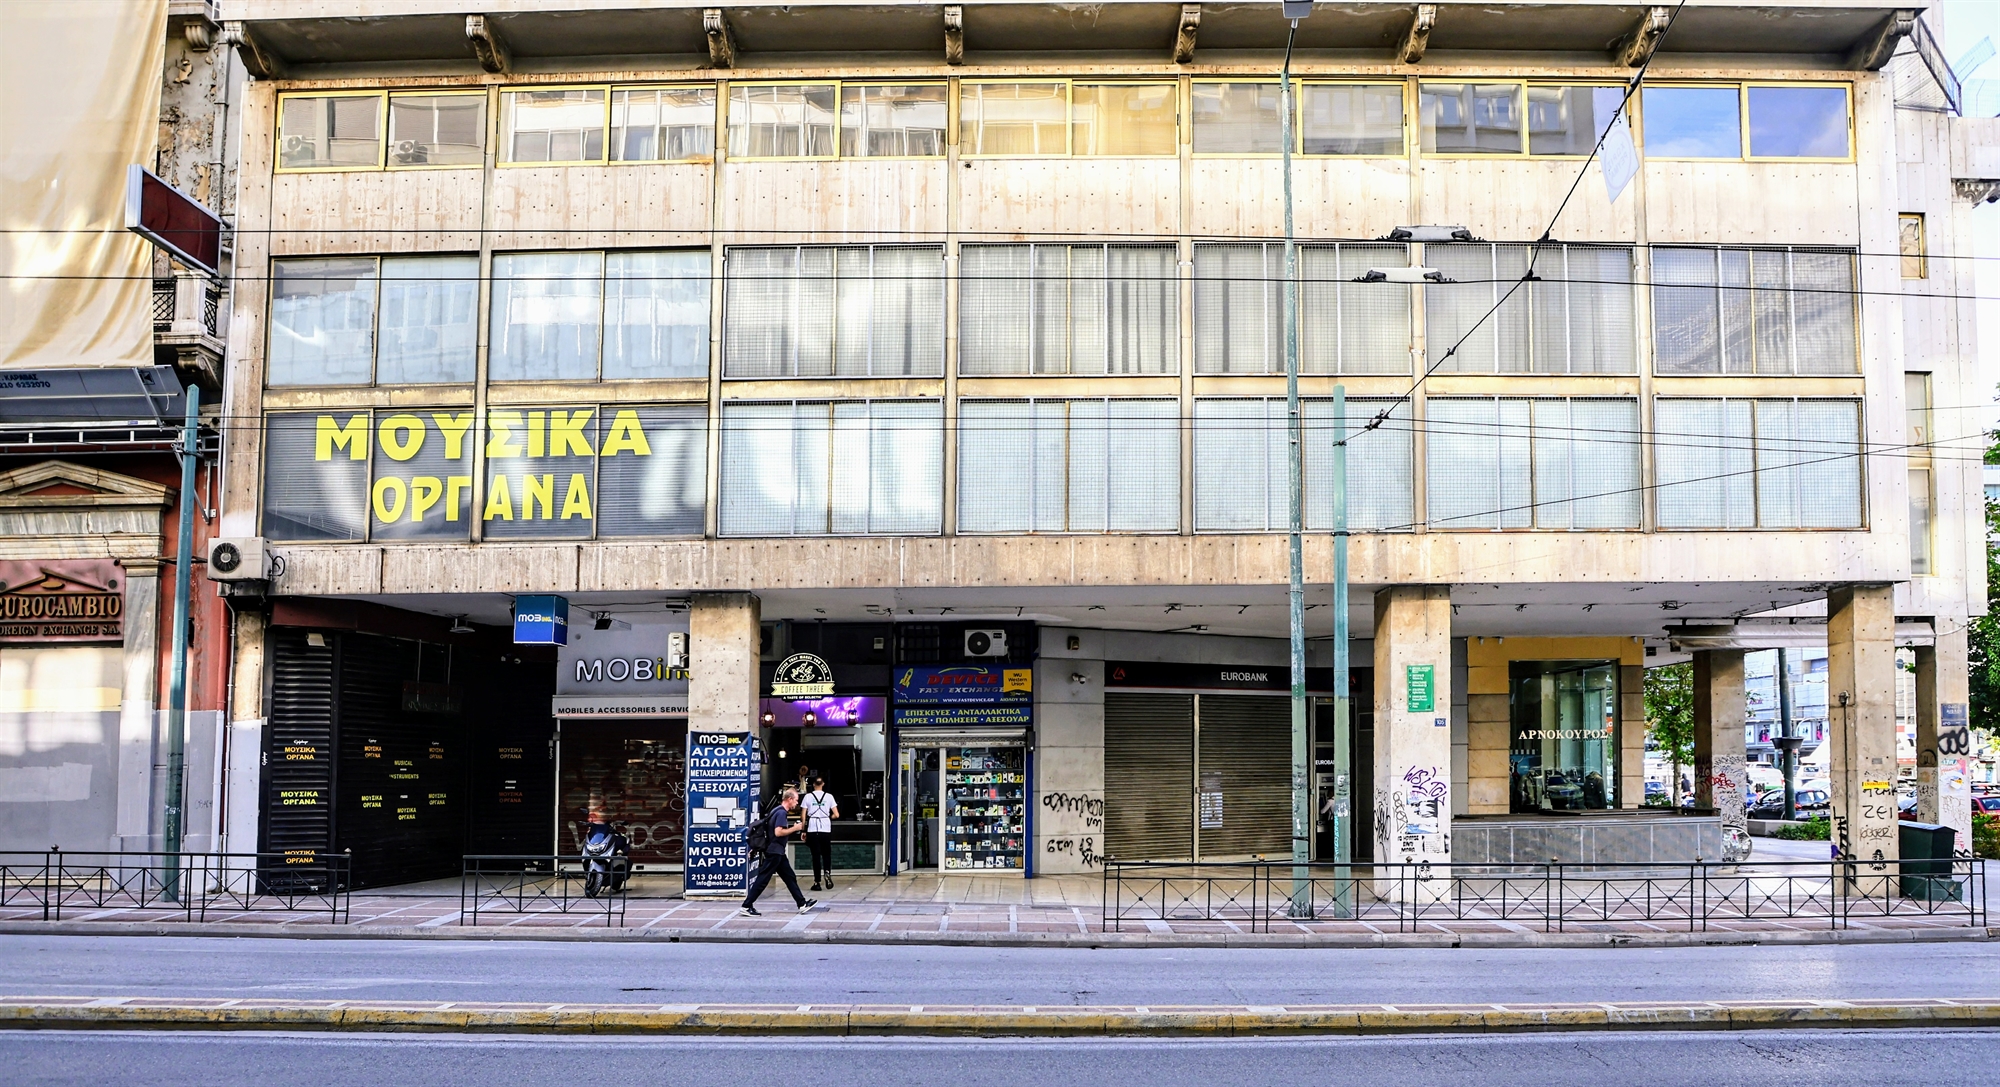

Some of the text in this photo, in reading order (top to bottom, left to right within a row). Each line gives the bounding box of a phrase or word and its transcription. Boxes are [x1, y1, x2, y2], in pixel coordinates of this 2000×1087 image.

[315, 409, 652, 461] ΜΟΥΣΙΚΑ
[372, 473, 593, 524] ΟΡΓΑΝΑ
[42, 625, 98, 636] EXCHANGE
[102, 624, 121, 636] S.A.
[927, 674, 999, 685] DEVICE
[1220, 671, 1268, 682] EUROBANK
[780, 684, 825, 694] COFFEE THREE
[597, 706, 657, 714] ACCESSORIES
[957, 708, 1021, 716] ΑΝΤΑΛΛΑΚΤΙΚΑ
[1518, 729, 1608, 740] ΑΡΝΟΚΟΥΡΟΣ
[691, 747, 748, 757] ΑΓΟΡΑ
[690, 758, 748, 767] ΠΩΛΗΣΗ
[690, 769, 748, 777] ΜΕΤΑΧΕΙΡΙΣΜΕΝΩΝ
[690, 783, 748, 792] ΑΞΕΣΟΥΑΡ
[693, 833, 742, 843] SERVICE
[688, 847, 747, 856] MOBILE
[688, 857, 746, 868] LAPTOP
